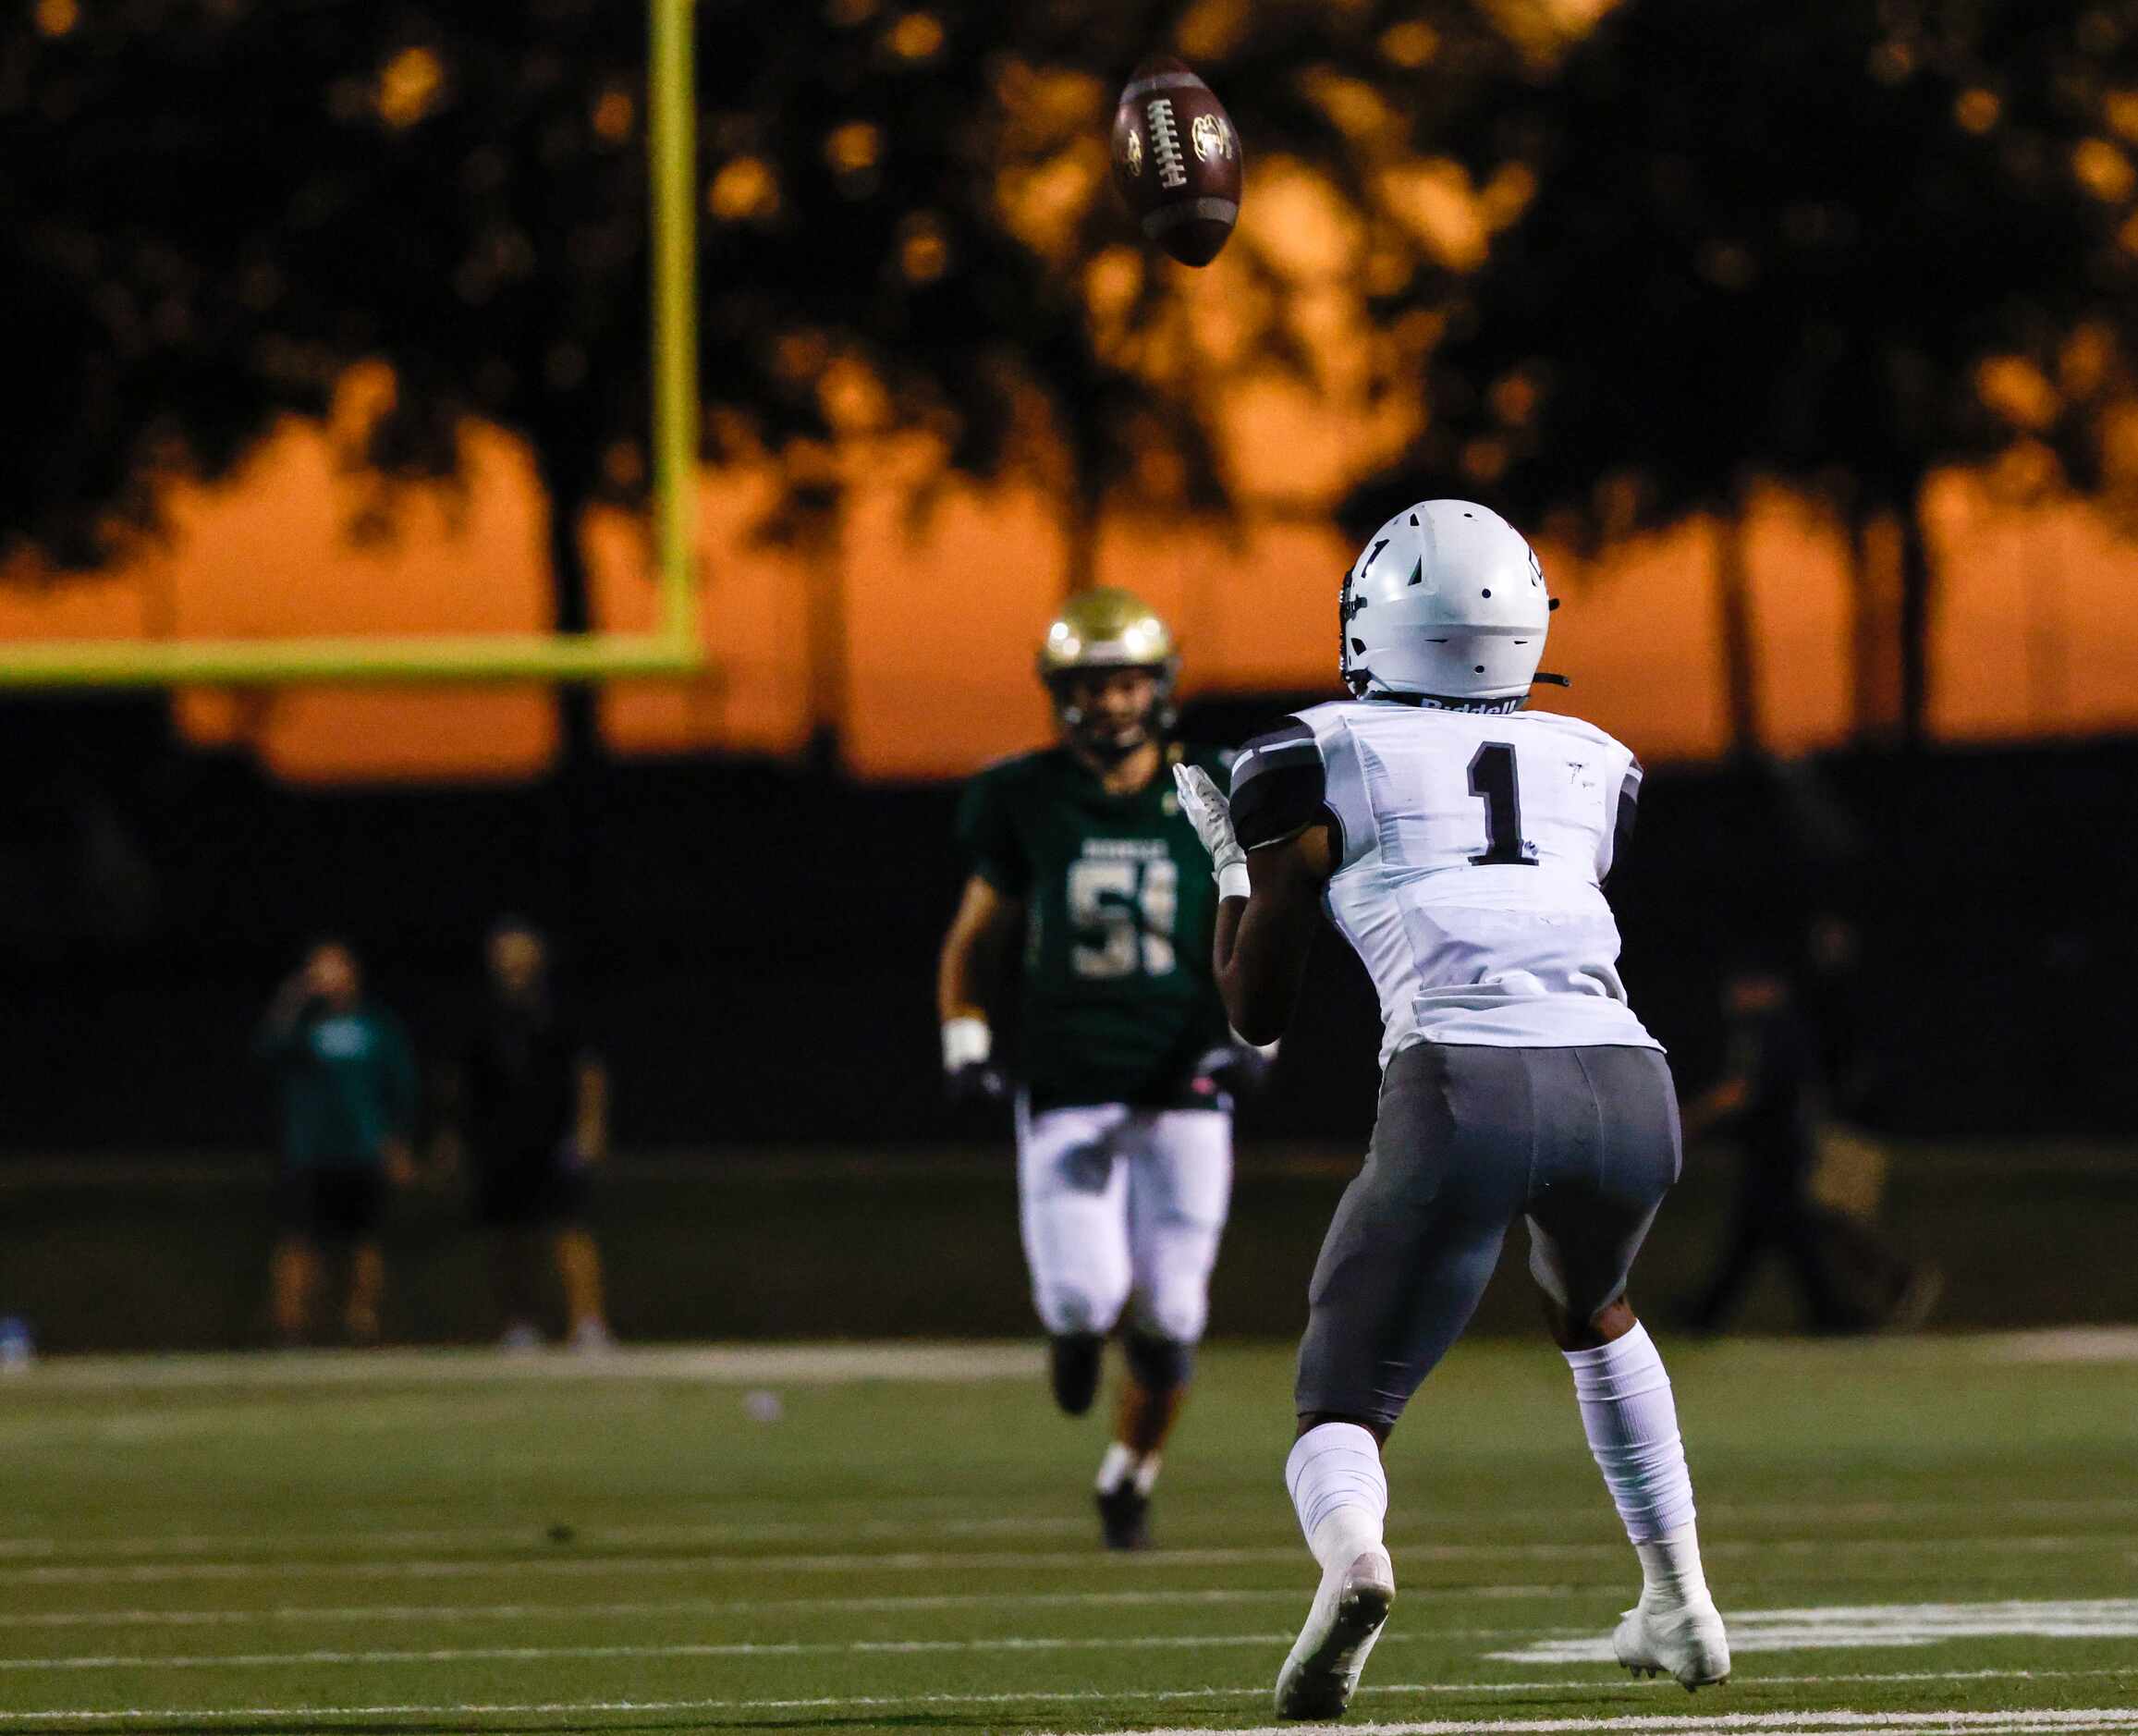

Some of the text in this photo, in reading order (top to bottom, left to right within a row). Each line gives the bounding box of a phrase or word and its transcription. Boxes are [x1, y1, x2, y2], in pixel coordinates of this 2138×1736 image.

[1421, 698, 1517, 715] Rddell
[1467, 741, 1539, 866] 1
[1068, 859, 1178, 977] 51
